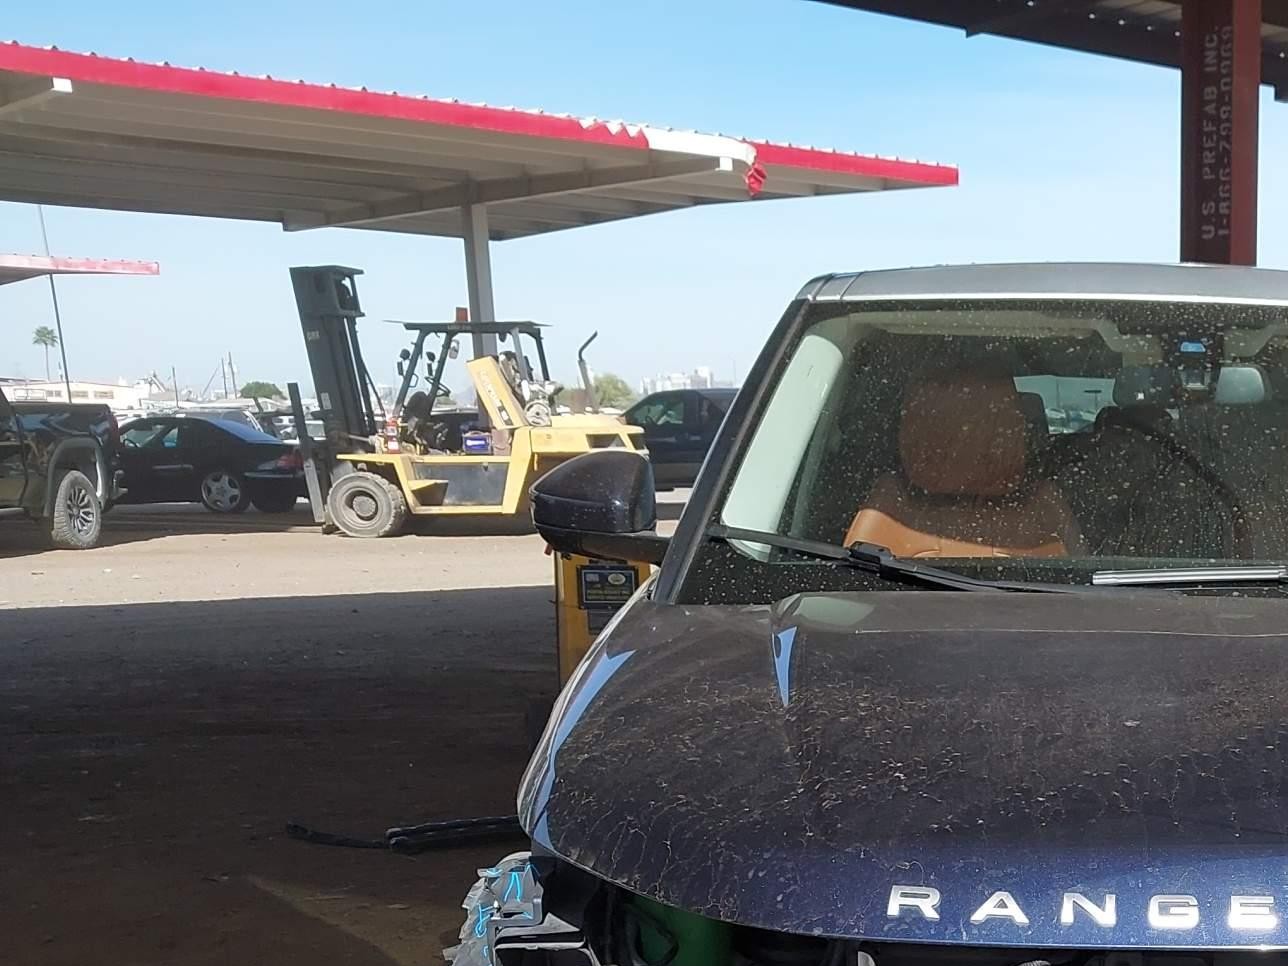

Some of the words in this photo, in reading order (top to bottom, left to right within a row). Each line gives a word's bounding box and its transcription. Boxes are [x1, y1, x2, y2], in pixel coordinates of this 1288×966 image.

[1204, 26, 1219, 73] INC.
[1202, 87, 1218, 180] PREFAB
[885, 885, 1279, 930] RANGE
